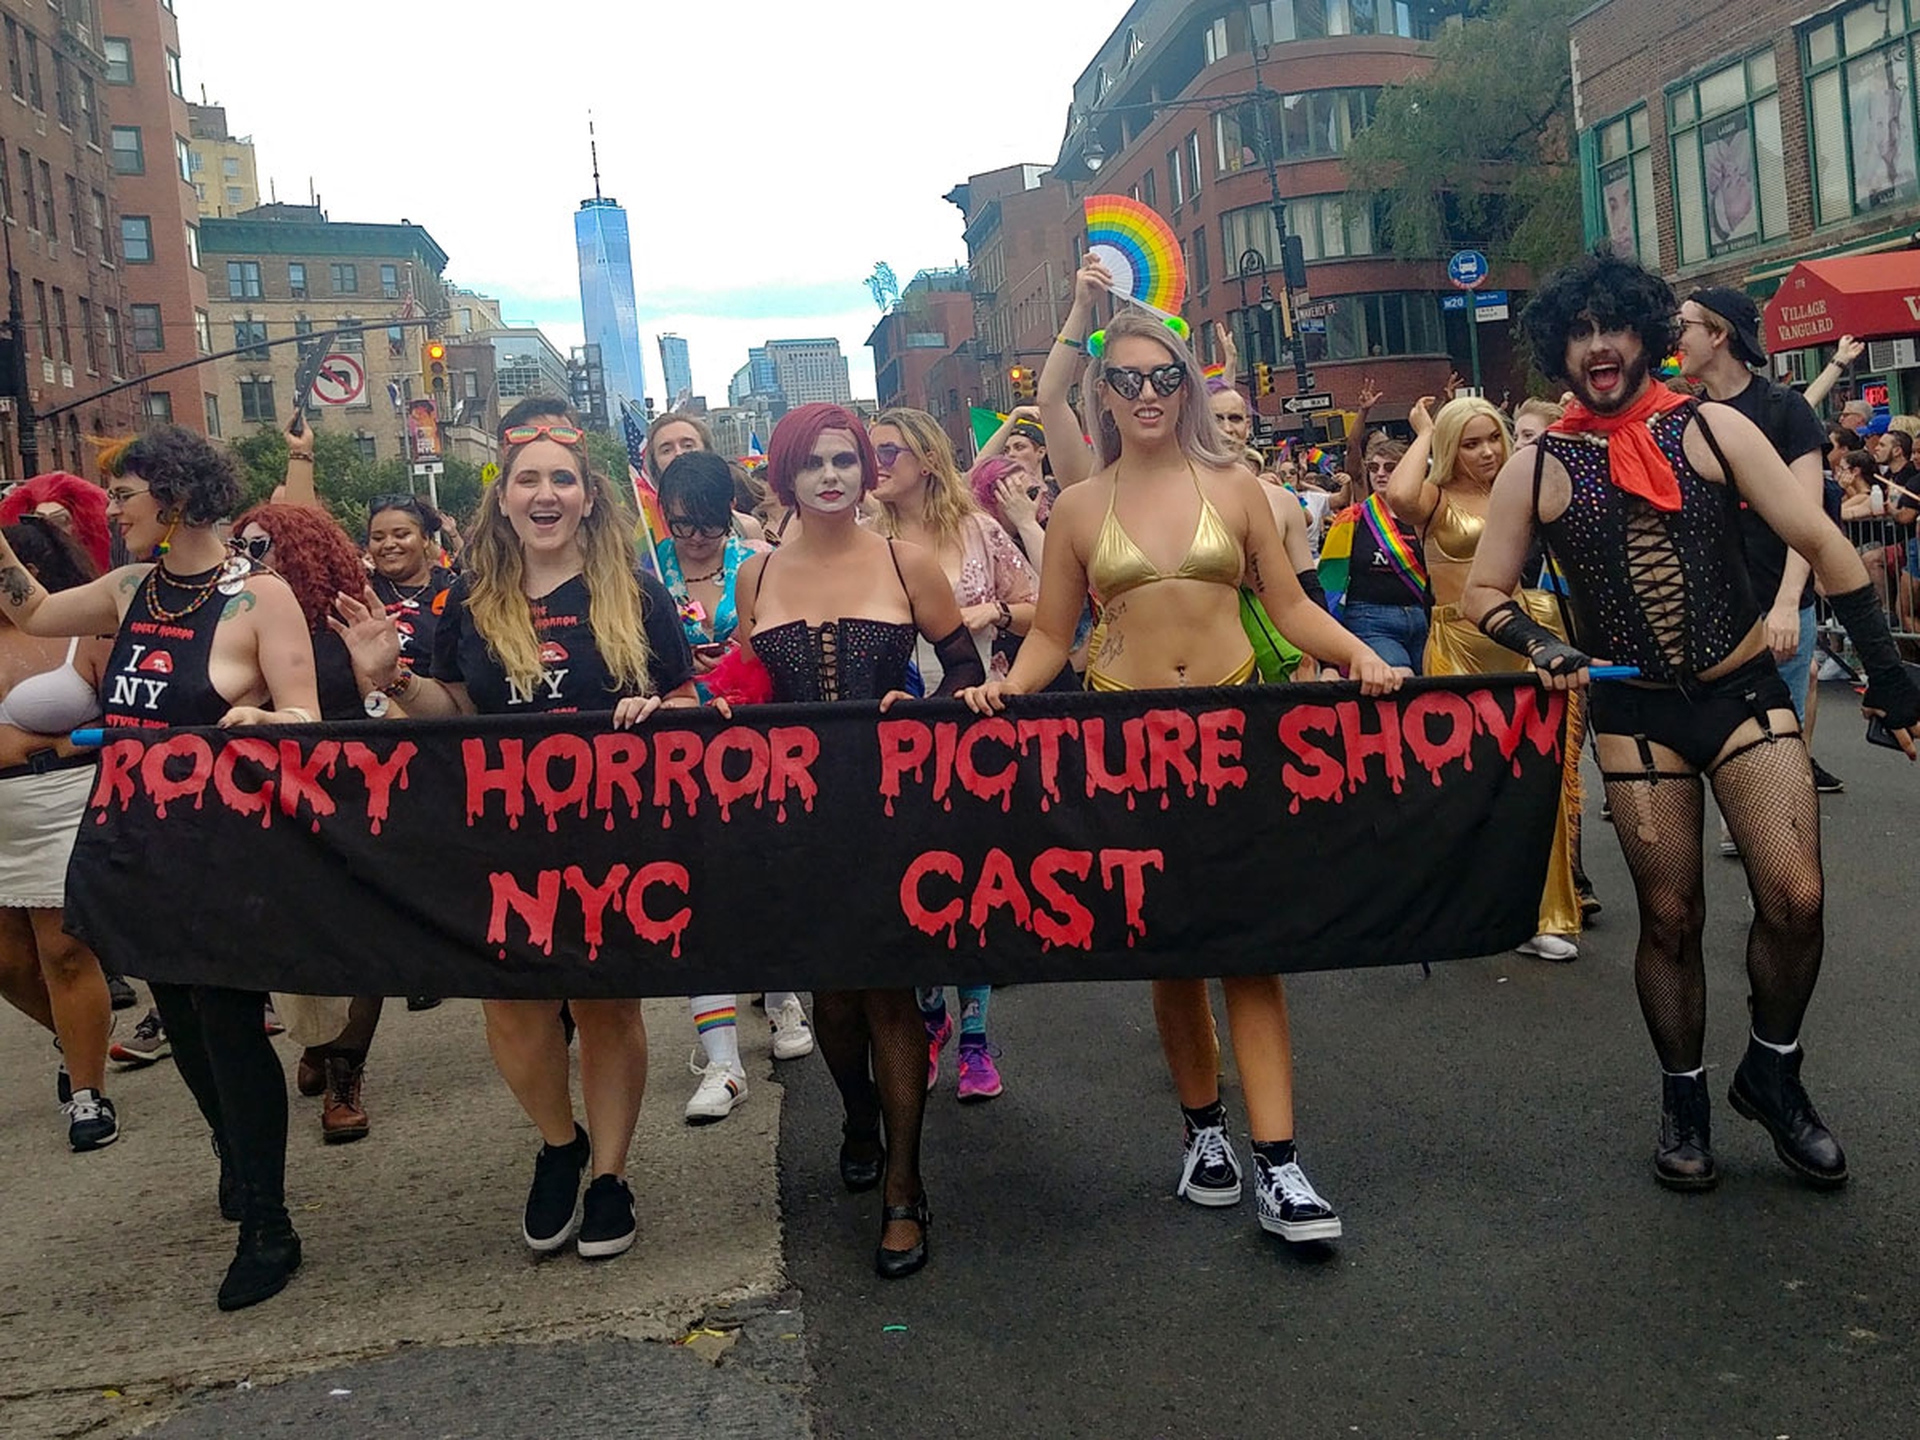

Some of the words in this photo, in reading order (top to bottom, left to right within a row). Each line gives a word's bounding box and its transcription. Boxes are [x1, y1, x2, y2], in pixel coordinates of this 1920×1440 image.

[1781, 300, 1827, 322] VILLAGE
[1778, 318, 1834, 341] VANGUARD
[124, 644, 146, 673] I
[108, 675, 168, 710] NY
[91, 733, 418, 836] ROCKY
[461, 726, 820, 832] HORROR
[877, 708, 1249, 817] PICTURE
[1278, 685, 1567, 815] SHOW
[487, 861, 692, 960] NYC
[900, 847, 1165, 953] CAST
